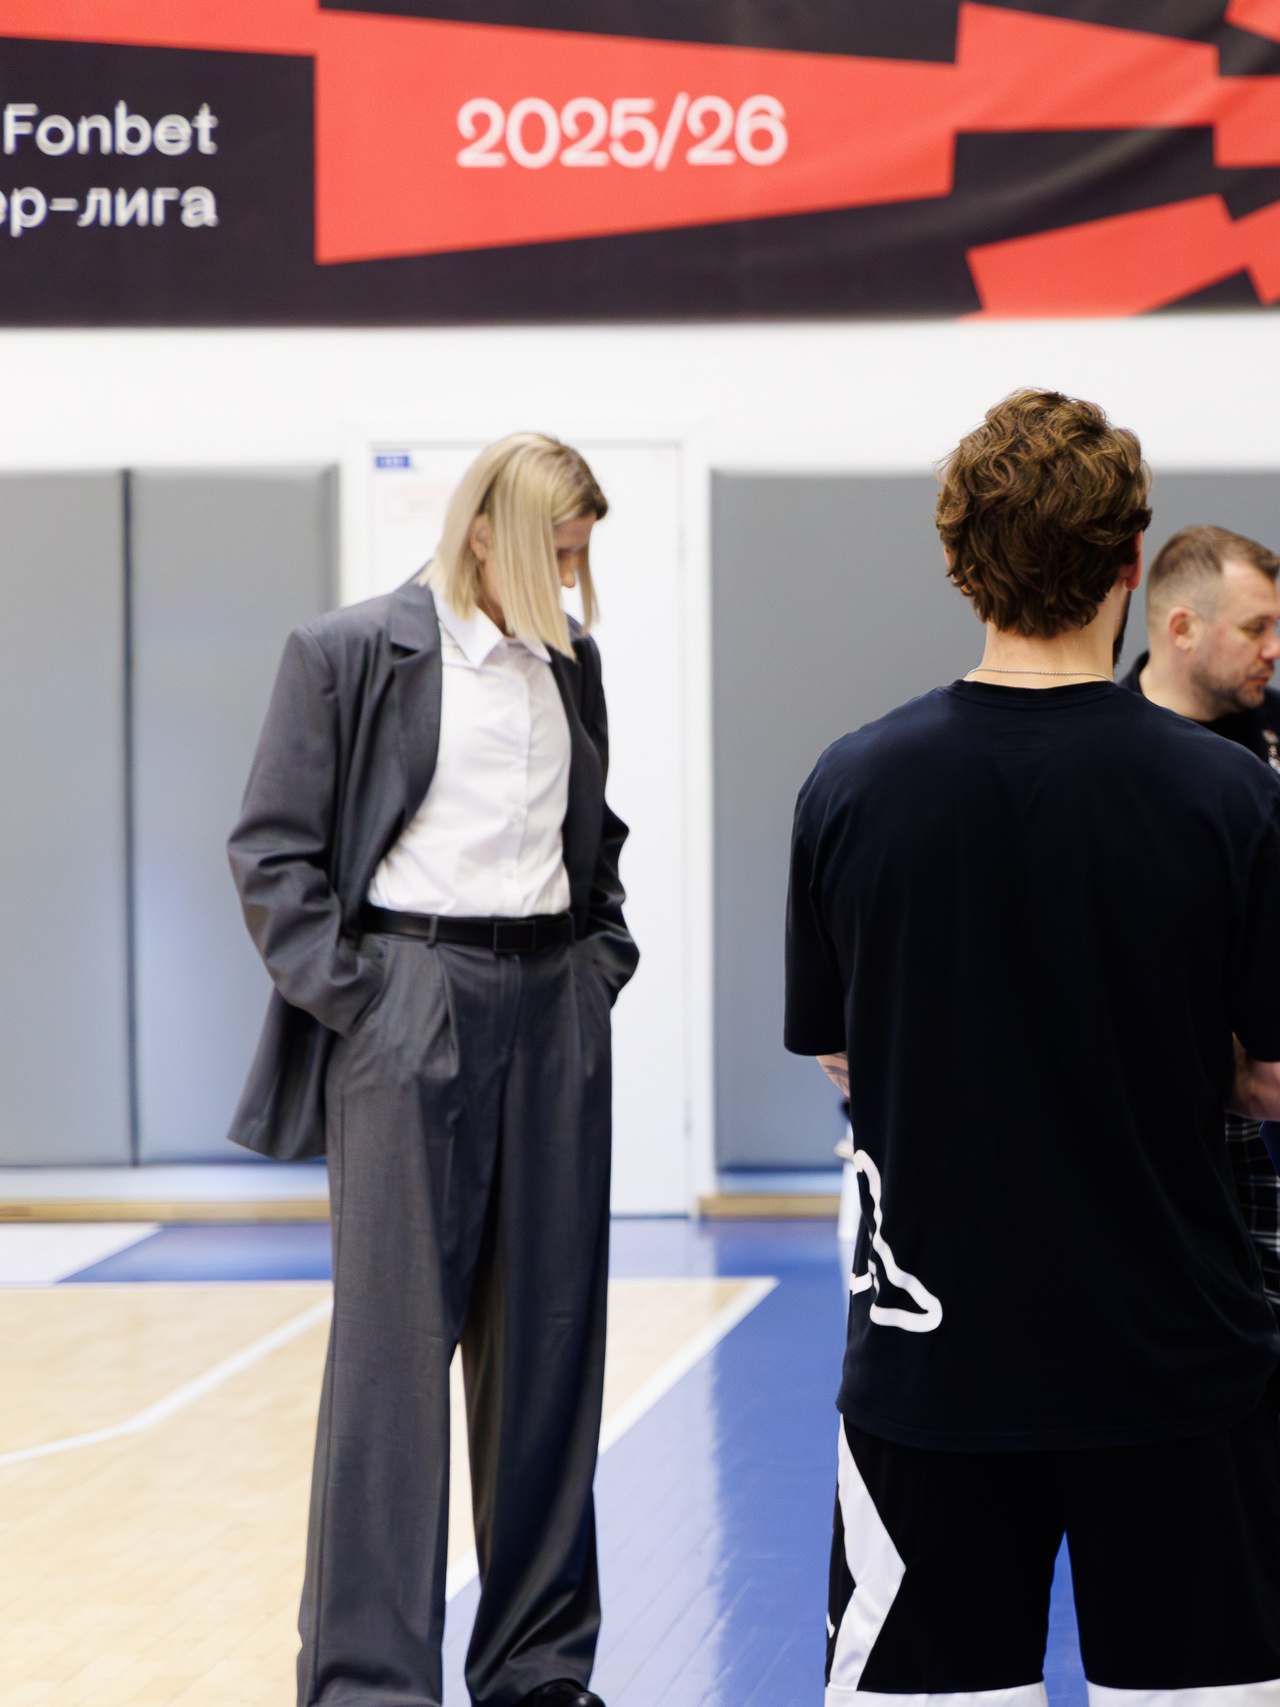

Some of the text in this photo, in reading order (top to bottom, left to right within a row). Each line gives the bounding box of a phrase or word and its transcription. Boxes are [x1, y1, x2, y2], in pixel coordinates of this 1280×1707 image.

[3, 99, 219, 156] Fonbet
[456, 91, 789, 172] 2025/26
[0, 185, 219, 238] р-лига
